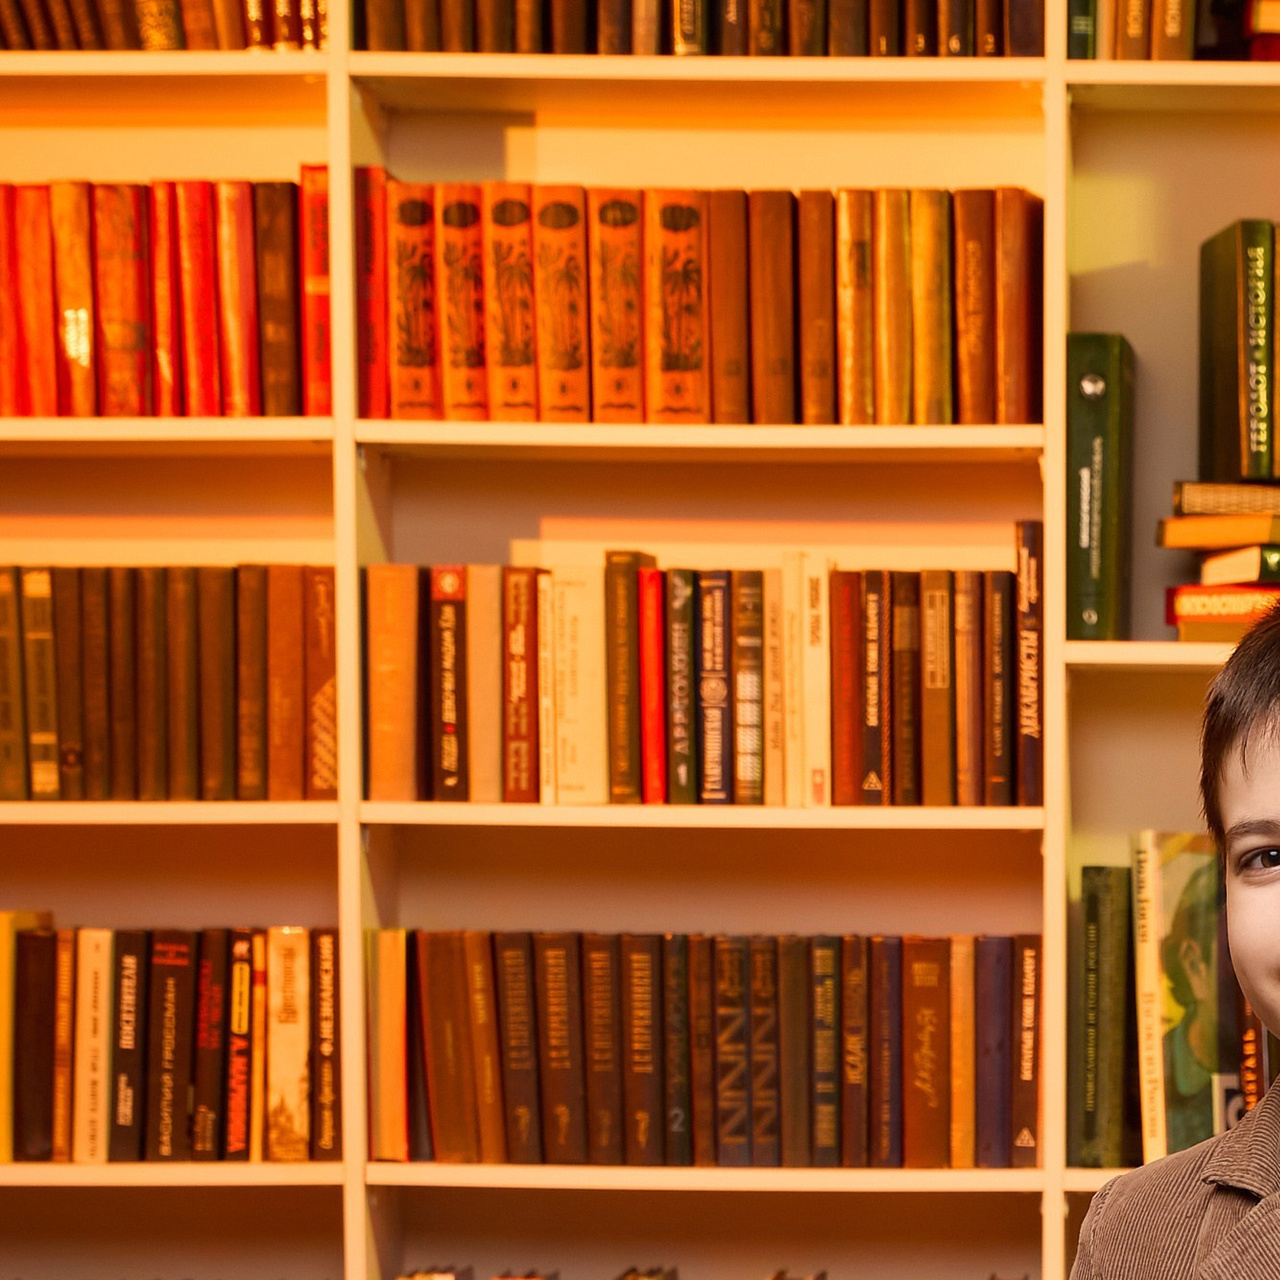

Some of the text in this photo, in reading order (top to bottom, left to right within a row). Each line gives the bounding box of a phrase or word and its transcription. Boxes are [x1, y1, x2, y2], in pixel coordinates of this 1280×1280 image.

[1247, 247, 1268, 453] ГЕРОДОТ ИСТОРИЯ
[1020, 630, 1040, 738] ДЕКАБРИСТЫ
